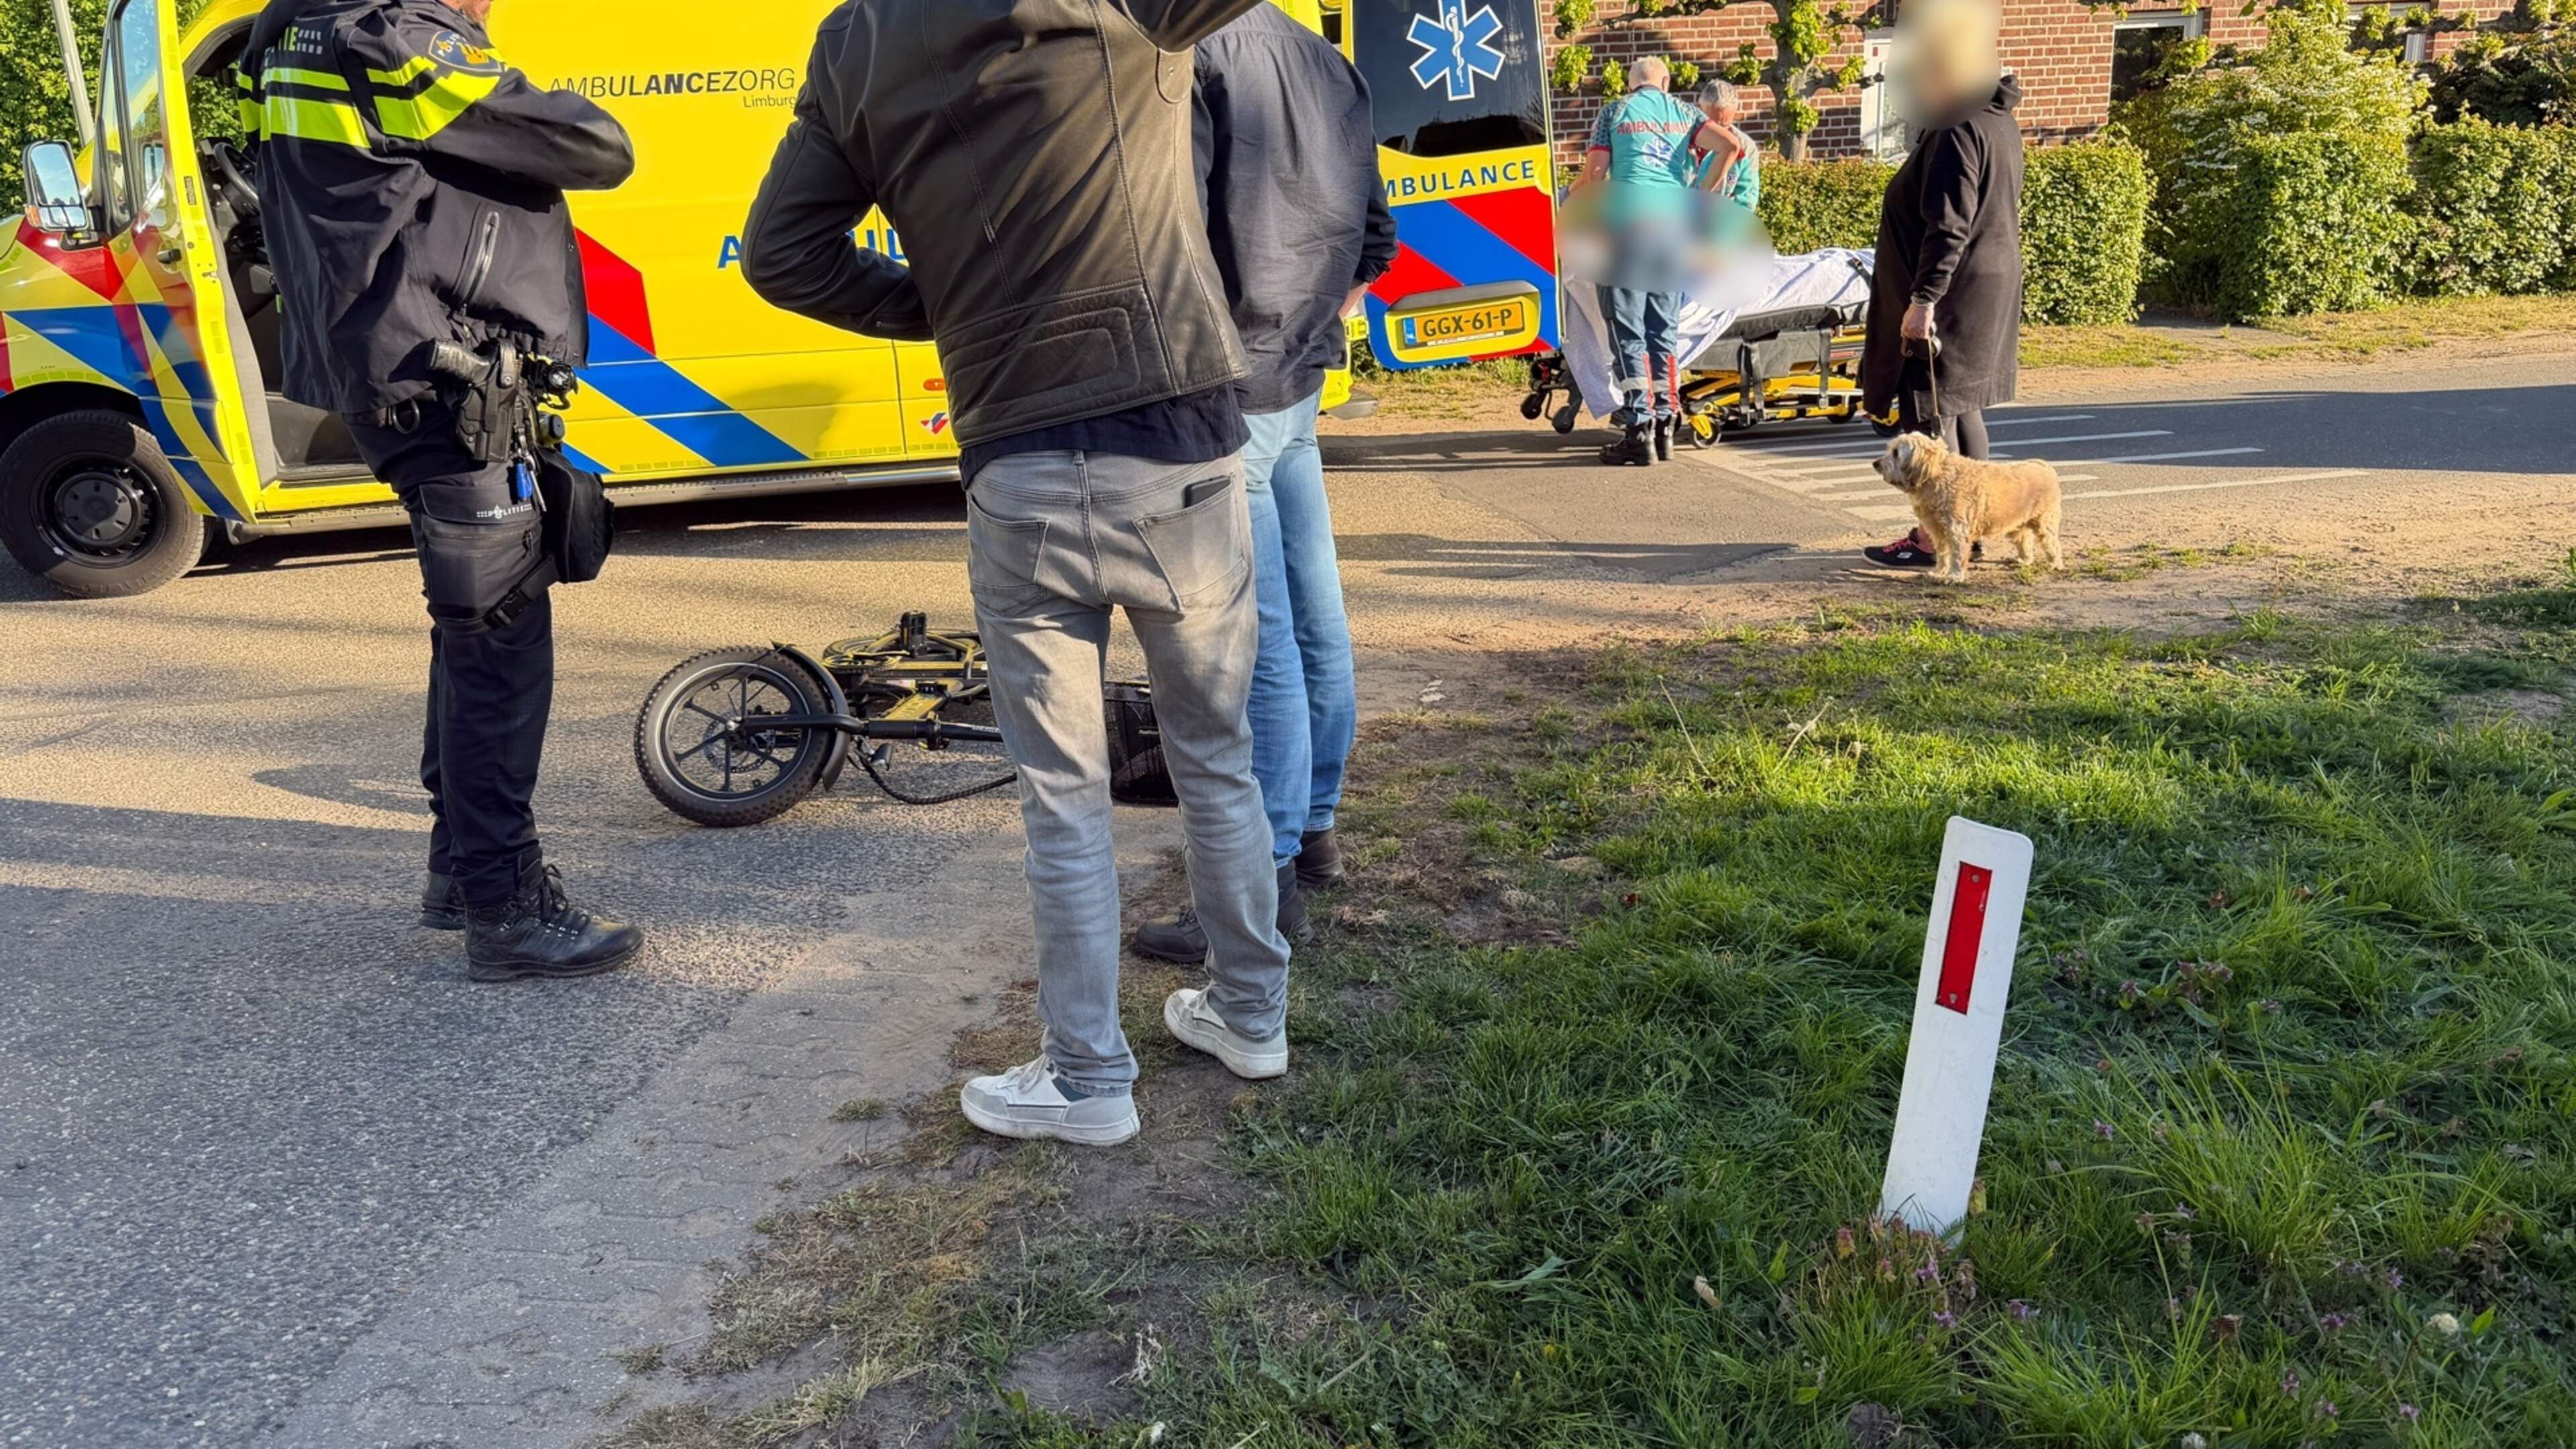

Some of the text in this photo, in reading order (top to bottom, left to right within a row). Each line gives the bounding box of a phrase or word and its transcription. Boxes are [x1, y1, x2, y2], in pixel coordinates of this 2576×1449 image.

[550, 68, 795, 98] AMBULANCEZORG
[743, 94, 796, 109] Limburg
[1385, 160, 1535, 198] MBULANCE
[1423, 309, 1512, 337] GGX-61-P
[488, 504, 525, 519] POLITIE
